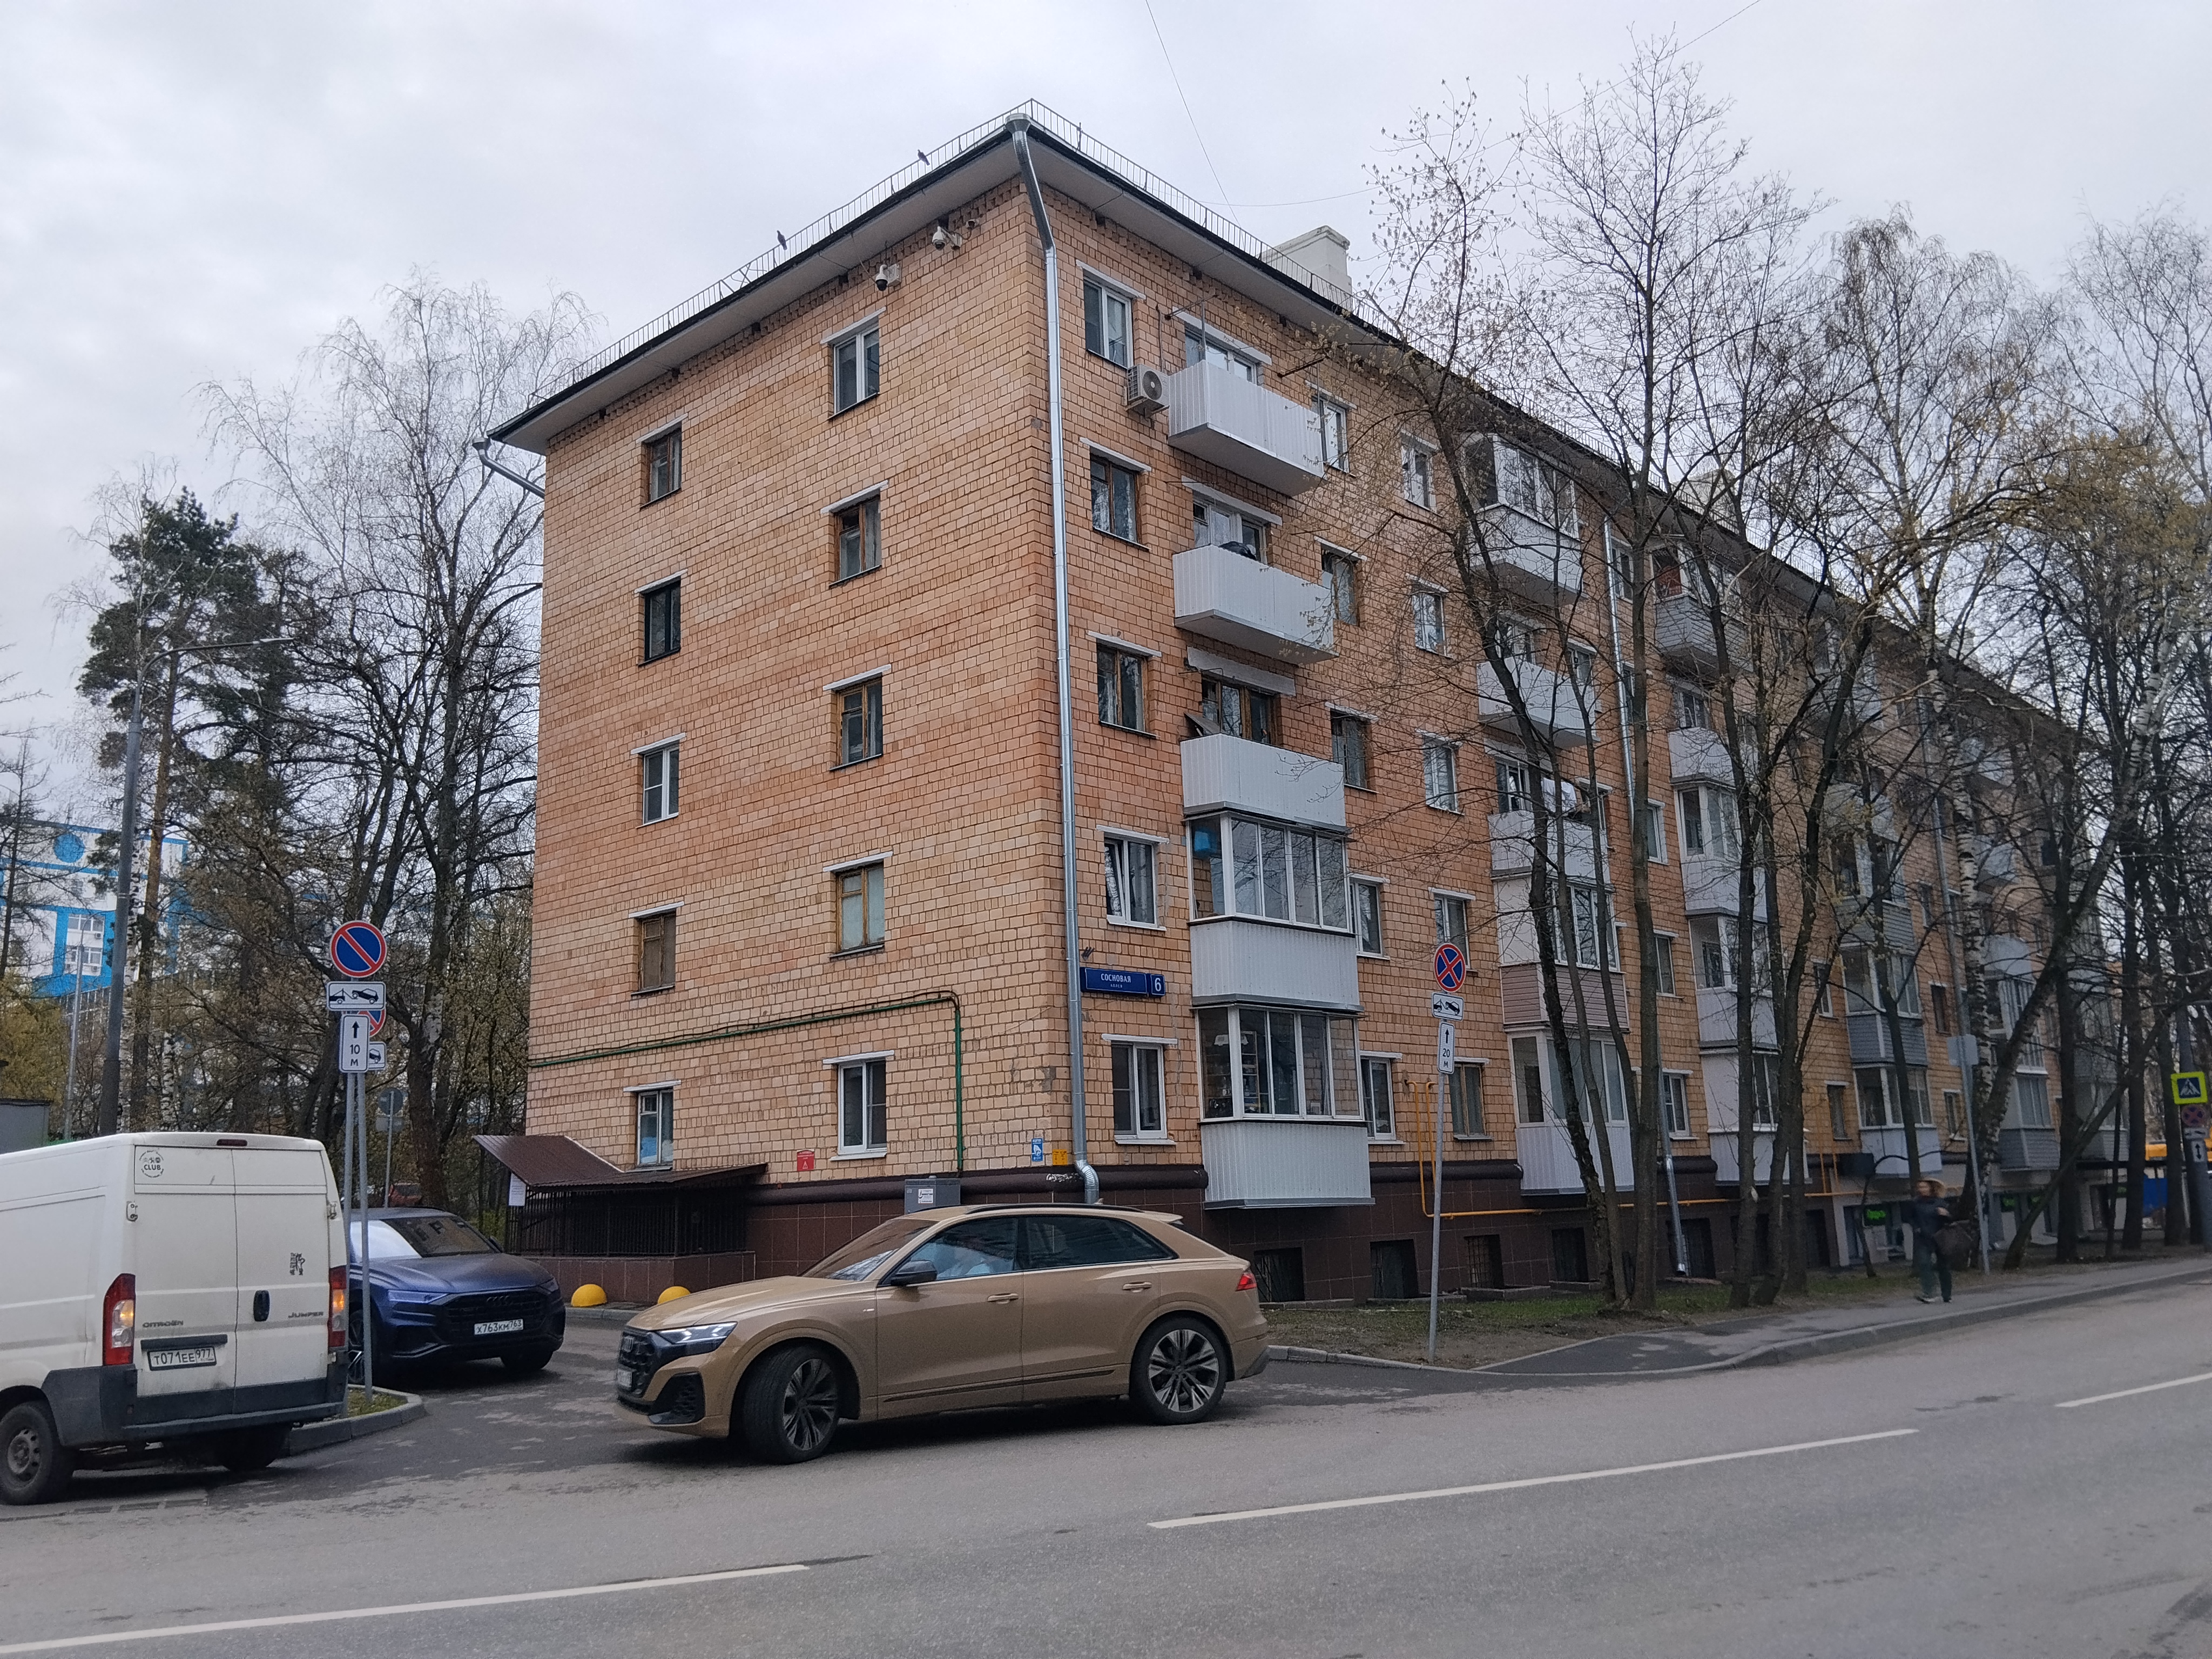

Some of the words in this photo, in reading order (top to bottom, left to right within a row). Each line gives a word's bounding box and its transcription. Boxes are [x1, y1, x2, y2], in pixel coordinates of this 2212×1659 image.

[1101, 973, 1131, 983] СОСНОВАЯ
[1155, 977, 1162, 992] 6
[350, 1044, 360, 1055] 10
[1442, 1048, 1451, 1058] 20
